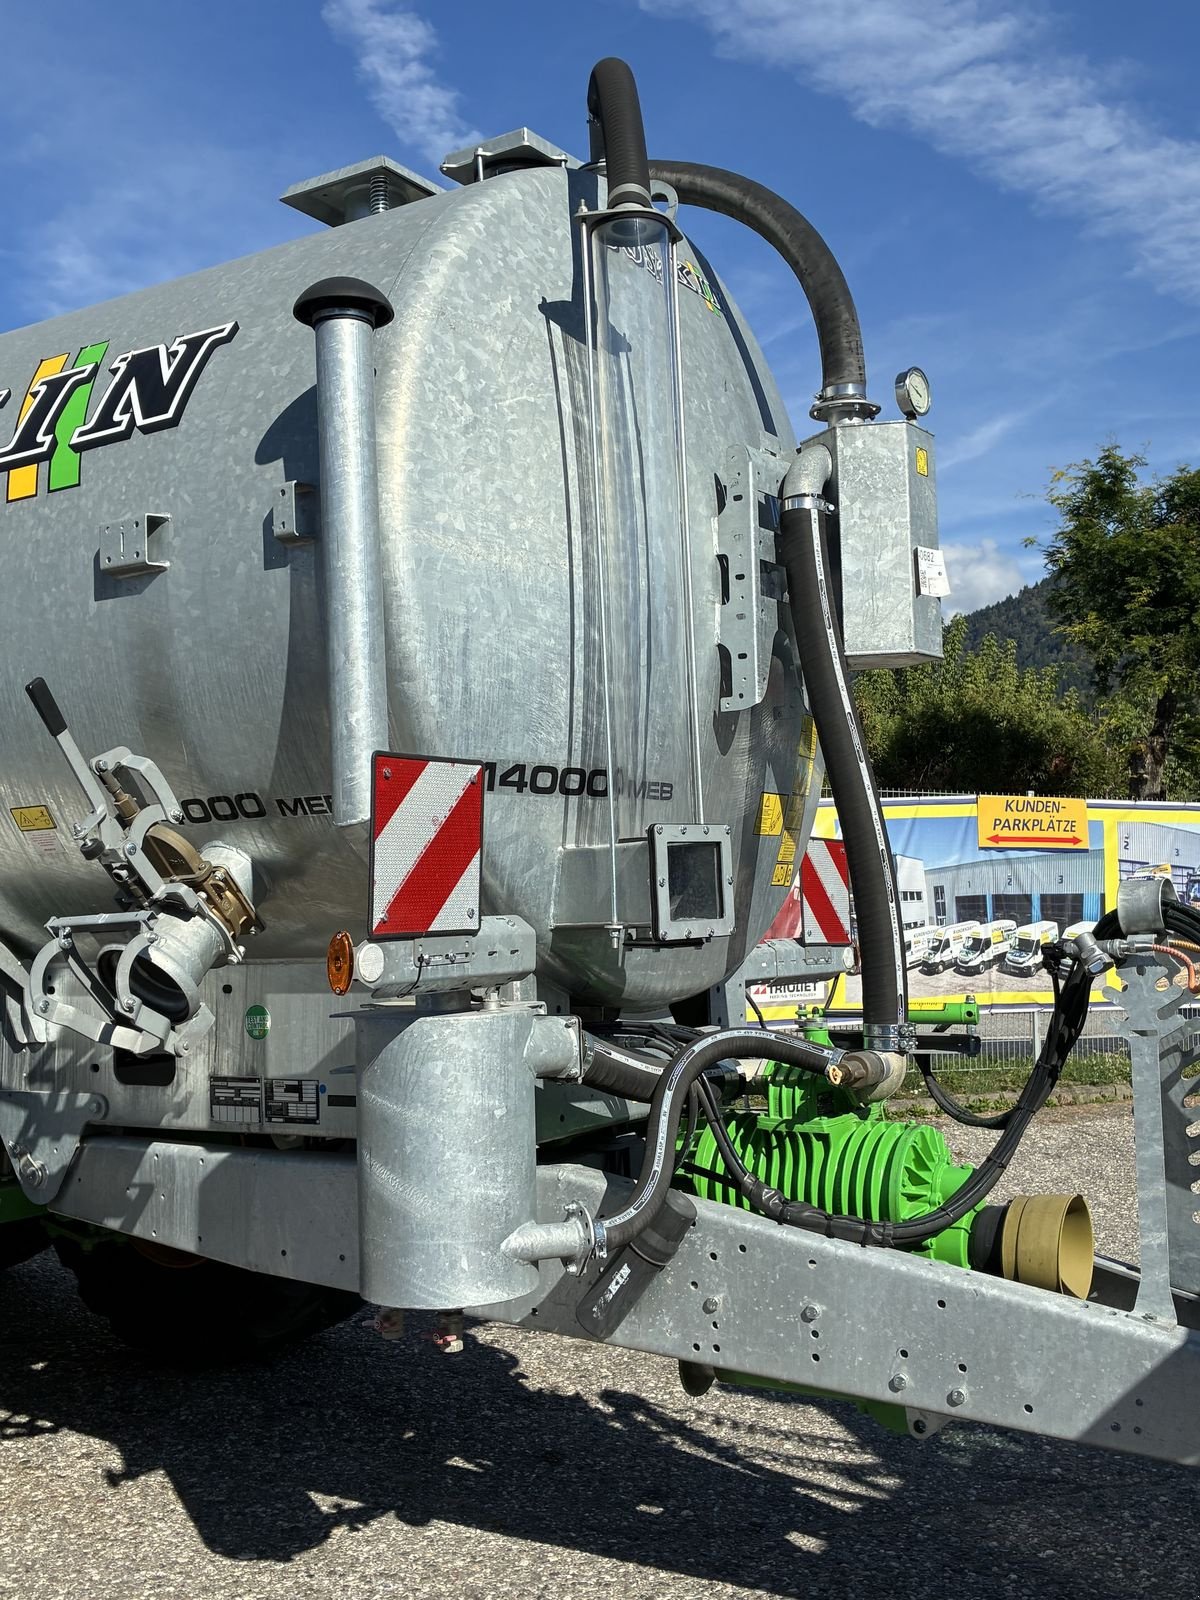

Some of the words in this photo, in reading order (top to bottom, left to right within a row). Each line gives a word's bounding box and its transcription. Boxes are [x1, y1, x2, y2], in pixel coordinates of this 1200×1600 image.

[0, 321, 240, 473] IN
[485, 761, 611, 798] 14000
[628, 779, 674, 801] MEB
[178, 793, 267, 825] 000
[1004, 799, 1067, 814] KUNDEN-
[992, 815, 1077, 833] PARKPLÄTZE
[1058, 875, 1064, 884] 3
